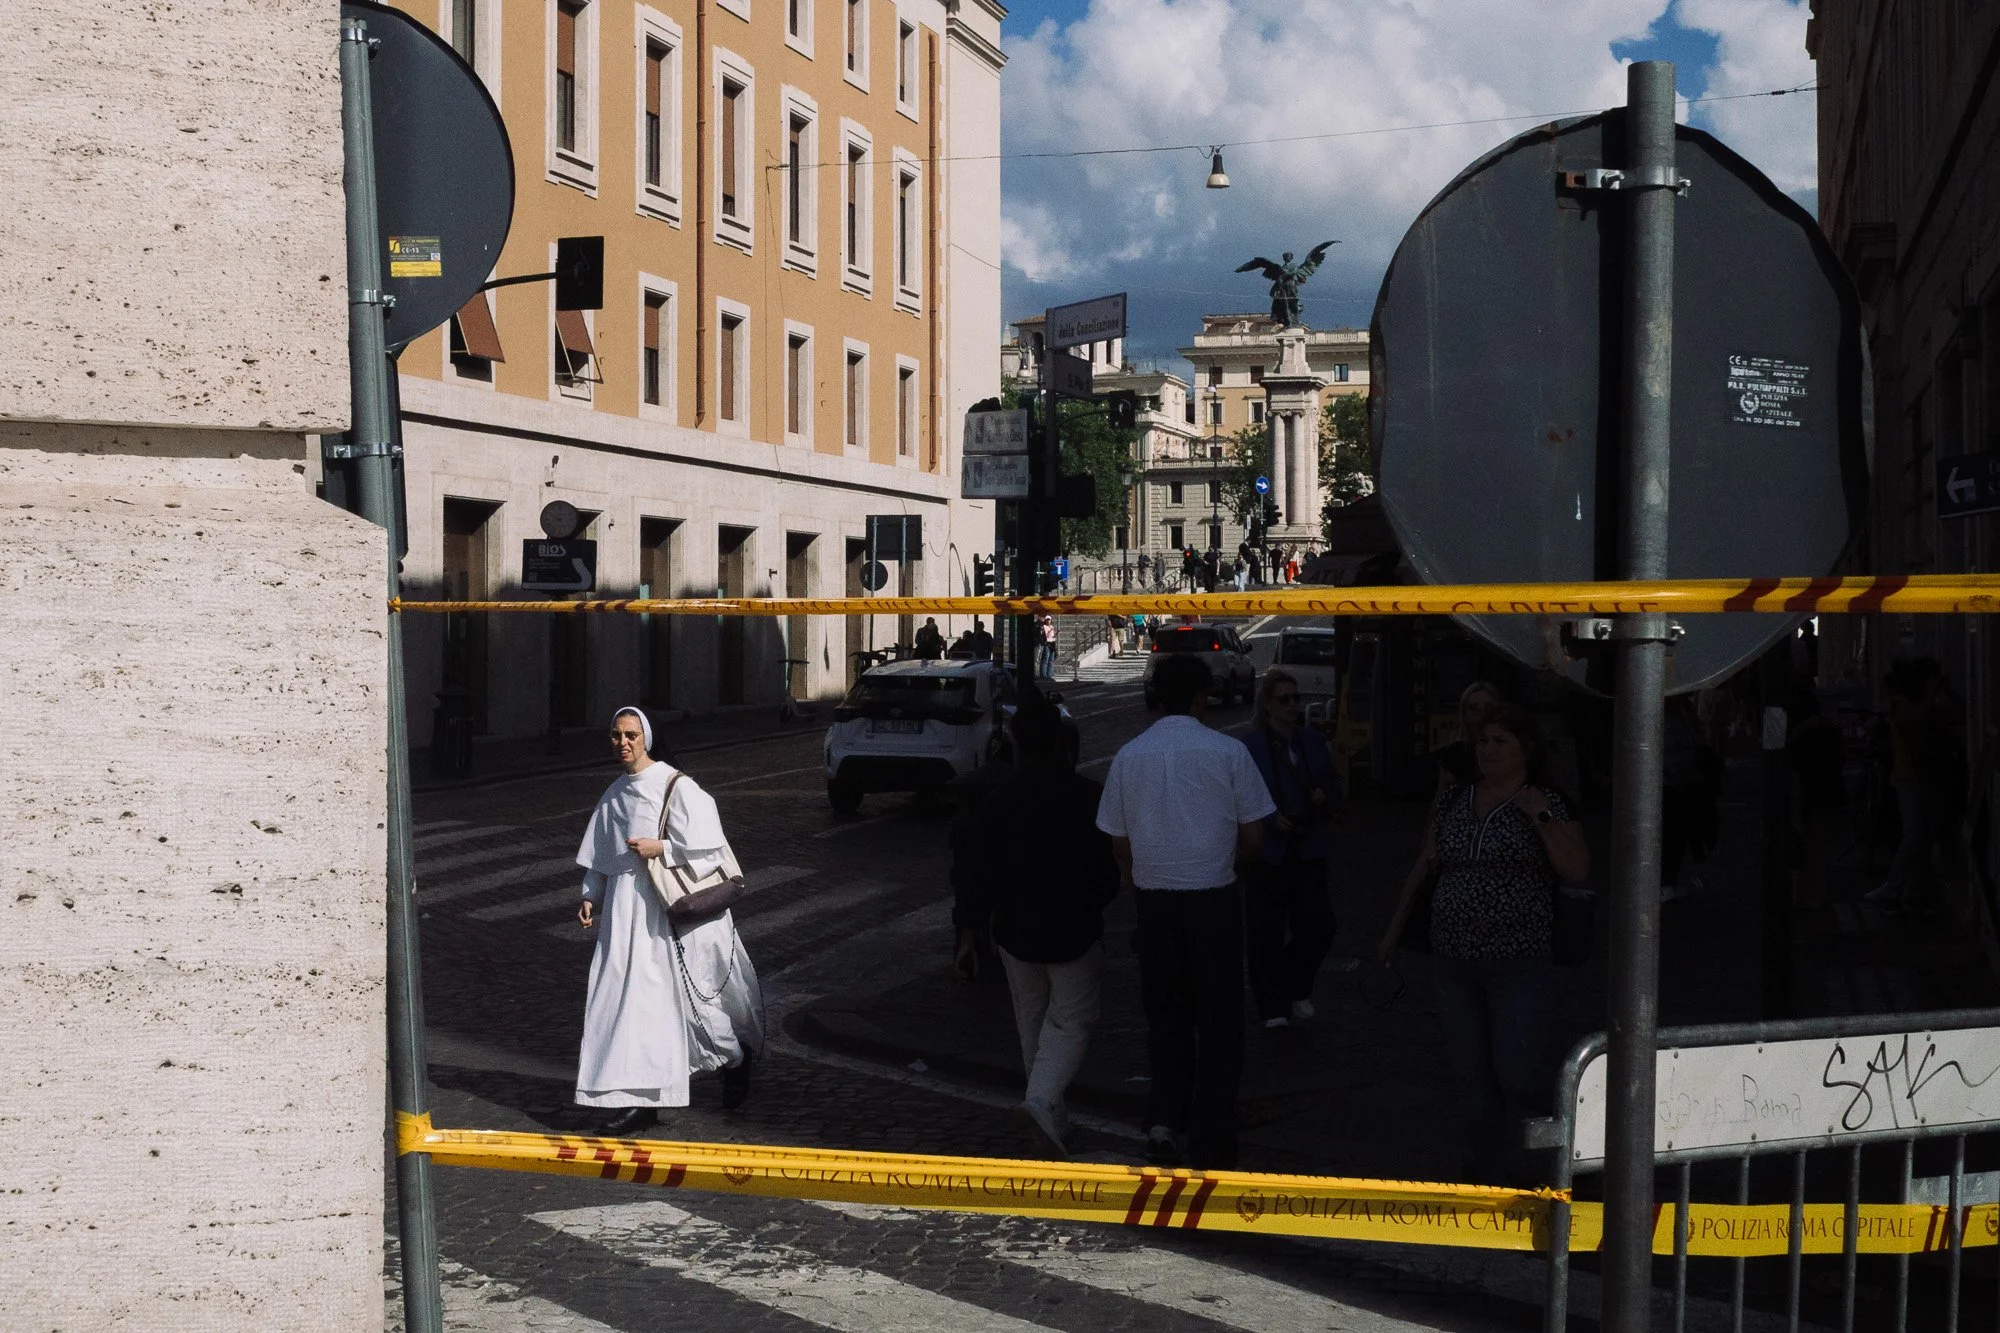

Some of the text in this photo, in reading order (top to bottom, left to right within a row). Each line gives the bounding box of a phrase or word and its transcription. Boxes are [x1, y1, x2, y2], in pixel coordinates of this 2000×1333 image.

[1077, 315, 1119, 336] Conciliazione
[1761, 393, 1787, 402] POLIZIA
[1761, 401, 1781, 409] ROMA
[982, 1175, 1109, 1203] CAPITALE
[1274, 1193, 1580, 1237] POLIZIA ROMA CAPITAE
[1701, 1217, 1770, 1240] POLIZIA
[1832, 1216, 1915, 1239] CPITALE
